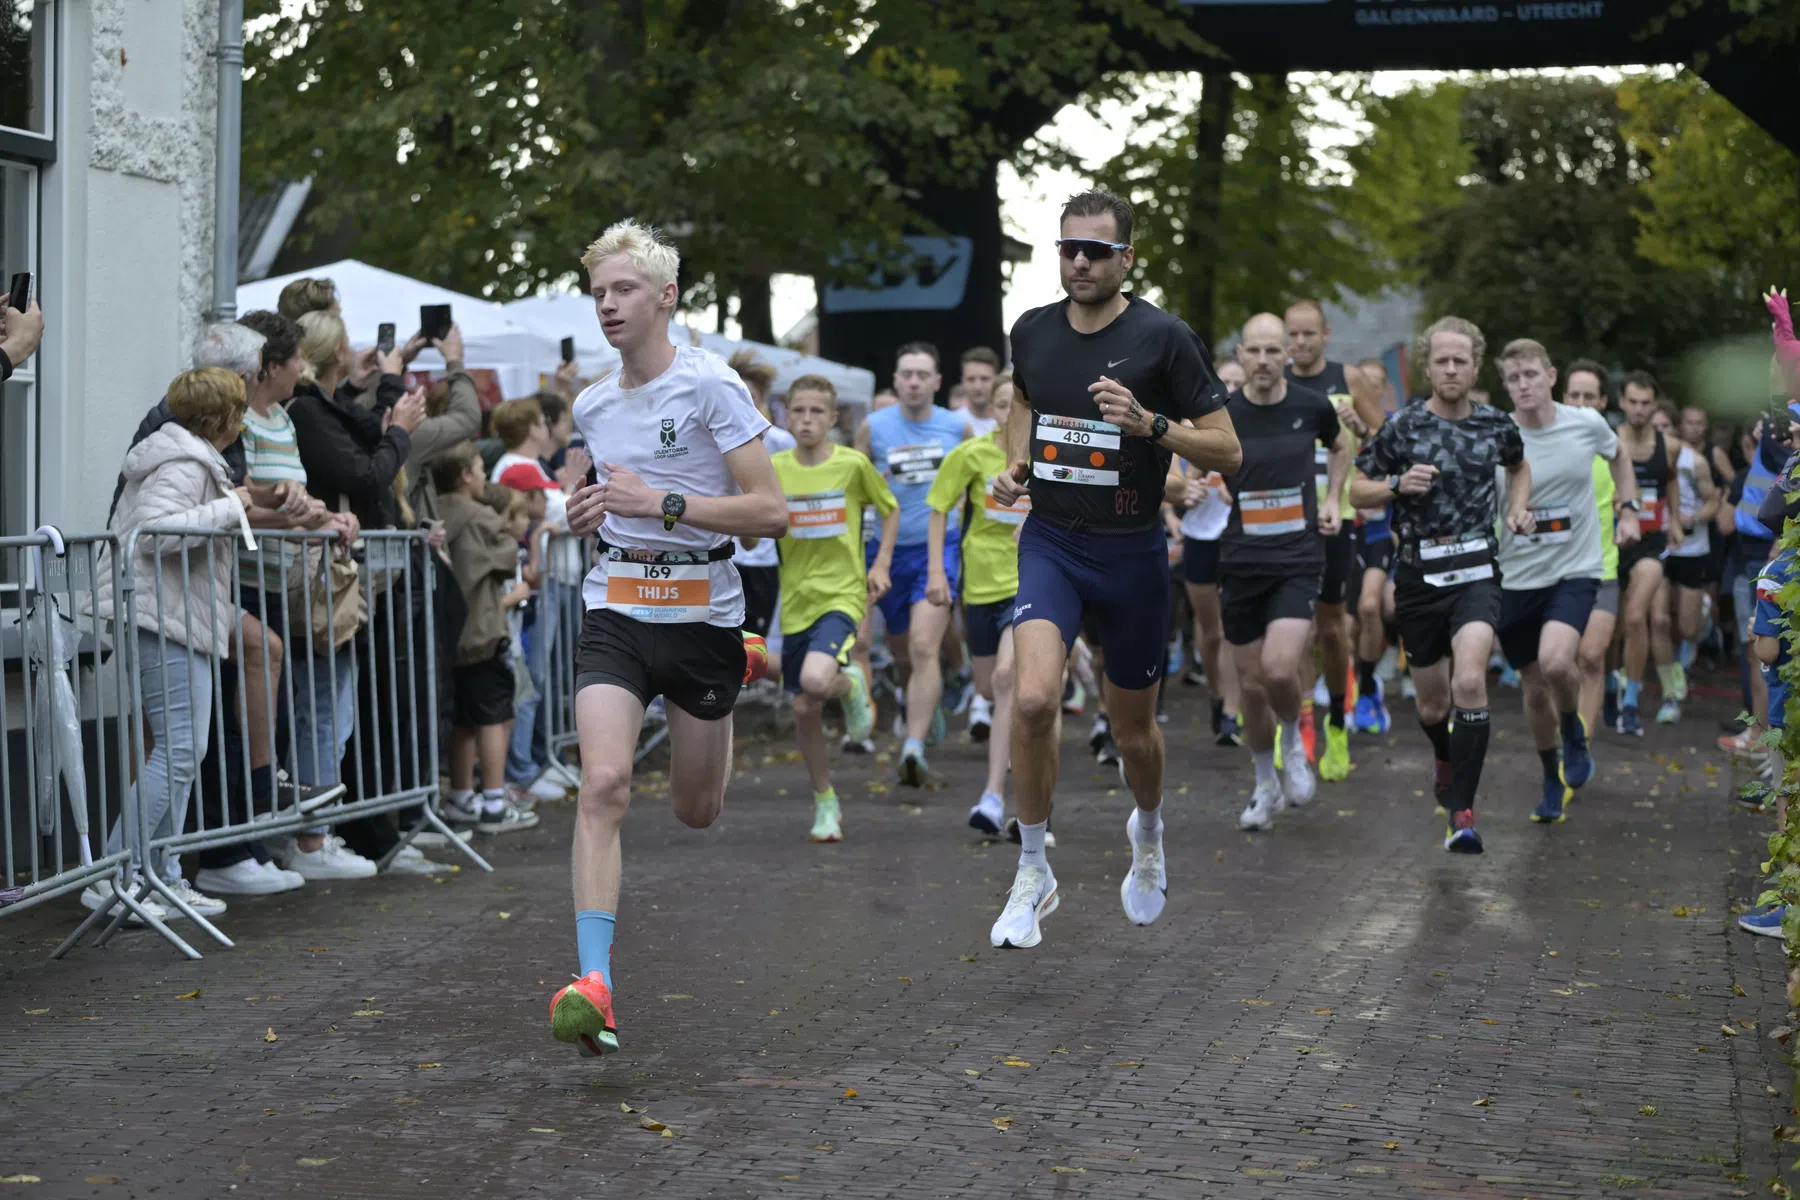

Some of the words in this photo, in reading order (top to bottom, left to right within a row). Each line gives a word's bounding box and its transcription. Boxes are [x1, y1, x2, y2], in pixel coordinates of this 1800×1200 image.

[1355, 5, 1499, 25] GALGENWAARD
[1516, 1, 1603, 21] UTRECHT
[1063, 431, 1090, 445] 430
[654, 446, 688, 455] UILENTOREN
[643, 565, 672, 579] 169
[637, 585, 679, 600] THIJS
